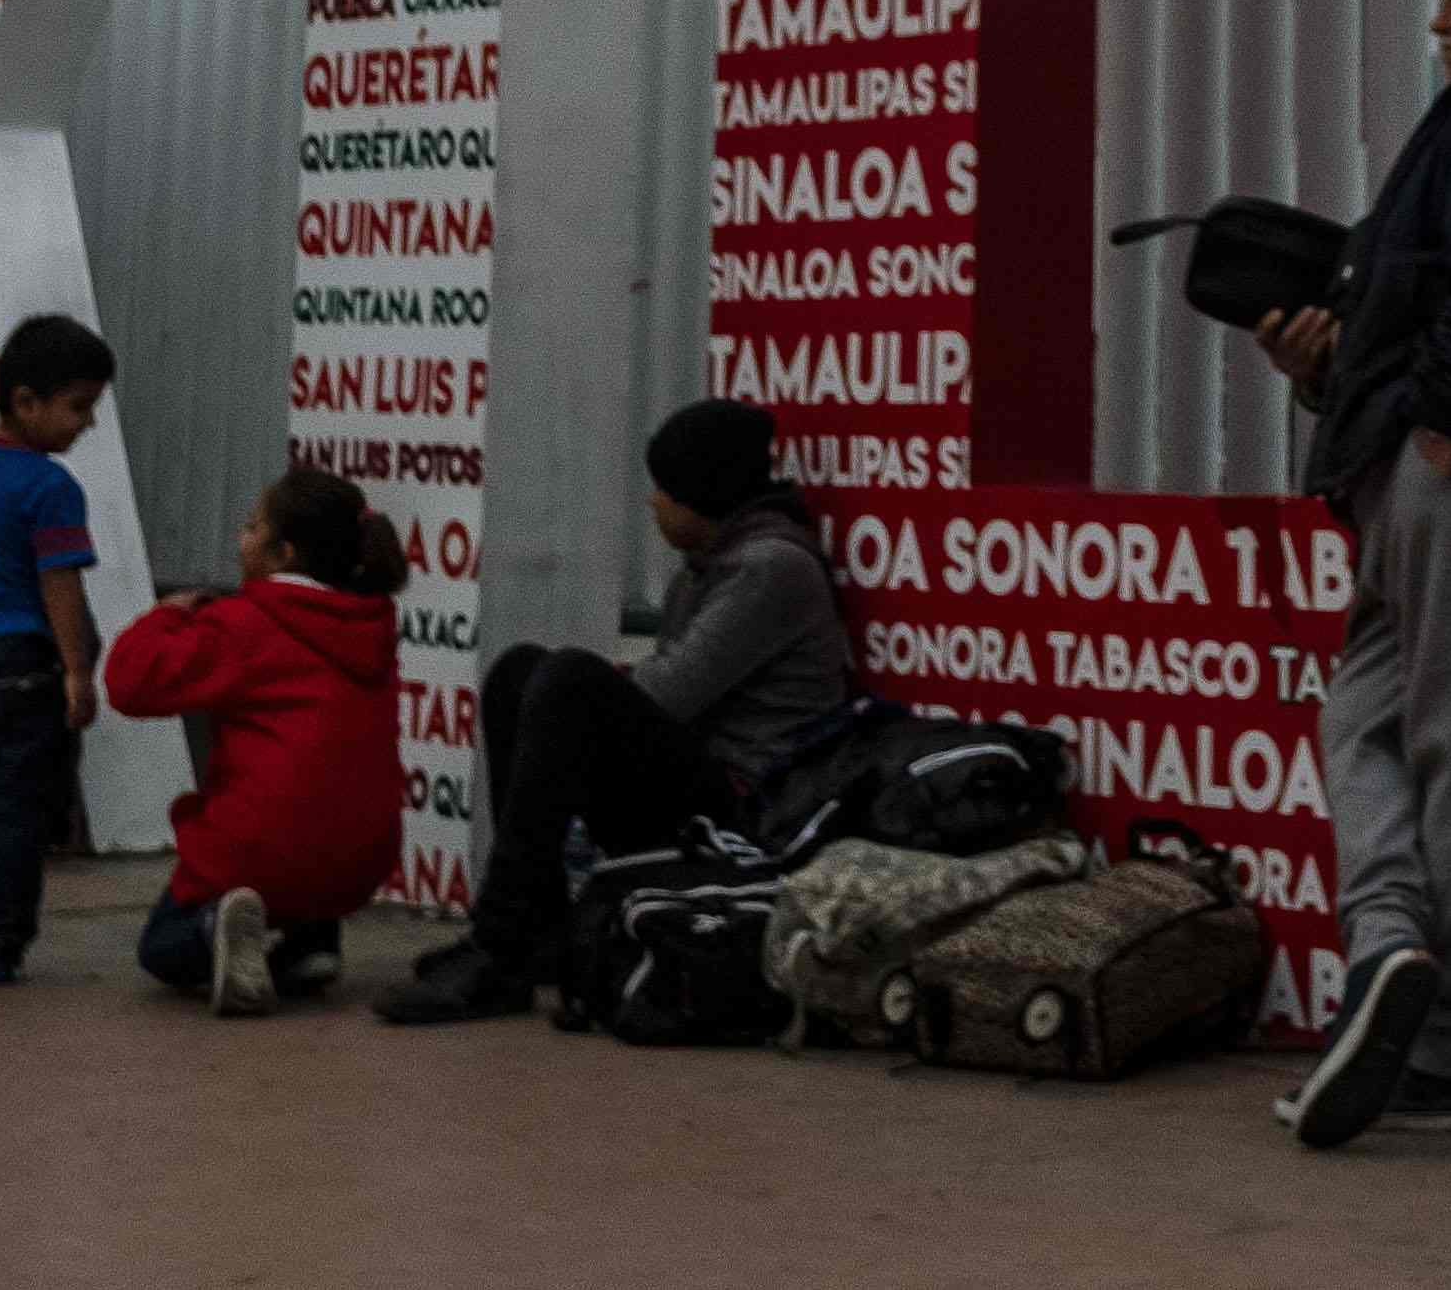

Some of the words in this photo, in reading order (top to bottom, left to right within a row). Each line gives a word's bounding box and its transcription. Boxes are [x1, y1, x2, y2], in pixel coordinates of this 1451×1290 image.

[714, 65, 934, 131] TAMAULIPAS
[301, 121, 455, 172] QUERÉTARO
[714, 148, 931, 225] SINALOA
[297, 200, 494, 257] QUINTANA
[294, 288, 422, 324] QUINTANA
[432, 289, 491, 326] ROO
[290, 356, 363, 410] SAN
[375, 359, 454, 415] LUIS
[712, 331, 969, 404] TAMAULIP
[339, 442, 390, 488] LUIS
[944, 519, 1209, 604] SONORA
[869, 623, 1036, 683] SONORA
[1048, 632, 1258, 699] TABASCO
